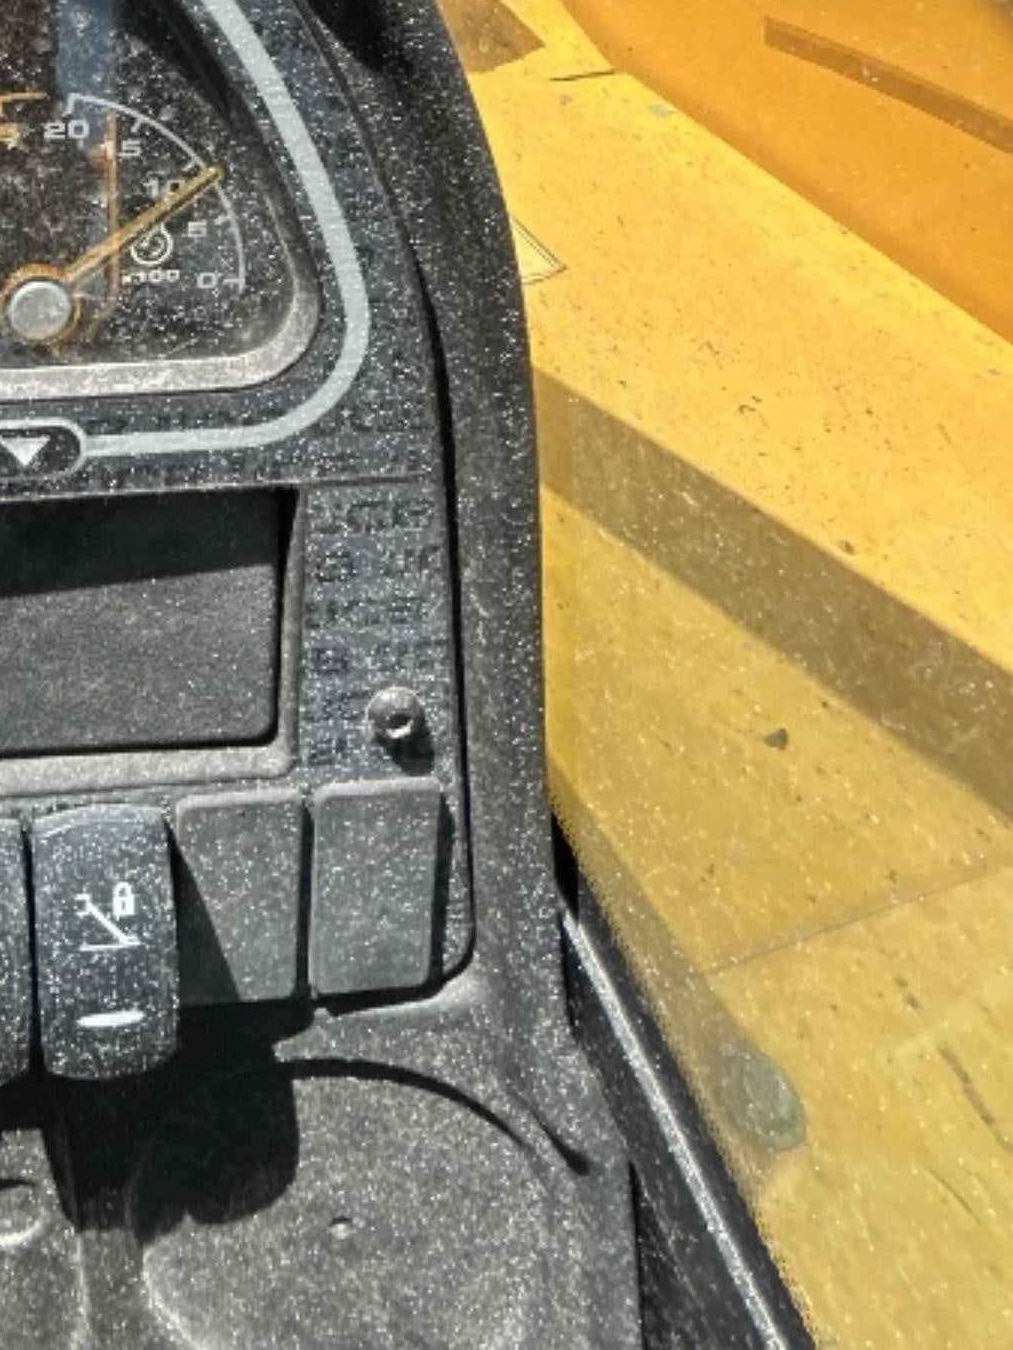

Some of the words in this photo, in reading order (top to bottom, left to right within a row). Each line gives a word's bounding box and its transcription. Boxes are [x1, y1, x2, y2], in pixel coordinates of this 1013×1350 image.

[43, 119, 89, 140] 20
[186, 220, 207, 238] 5
[196, 272, 218, 289] 0
